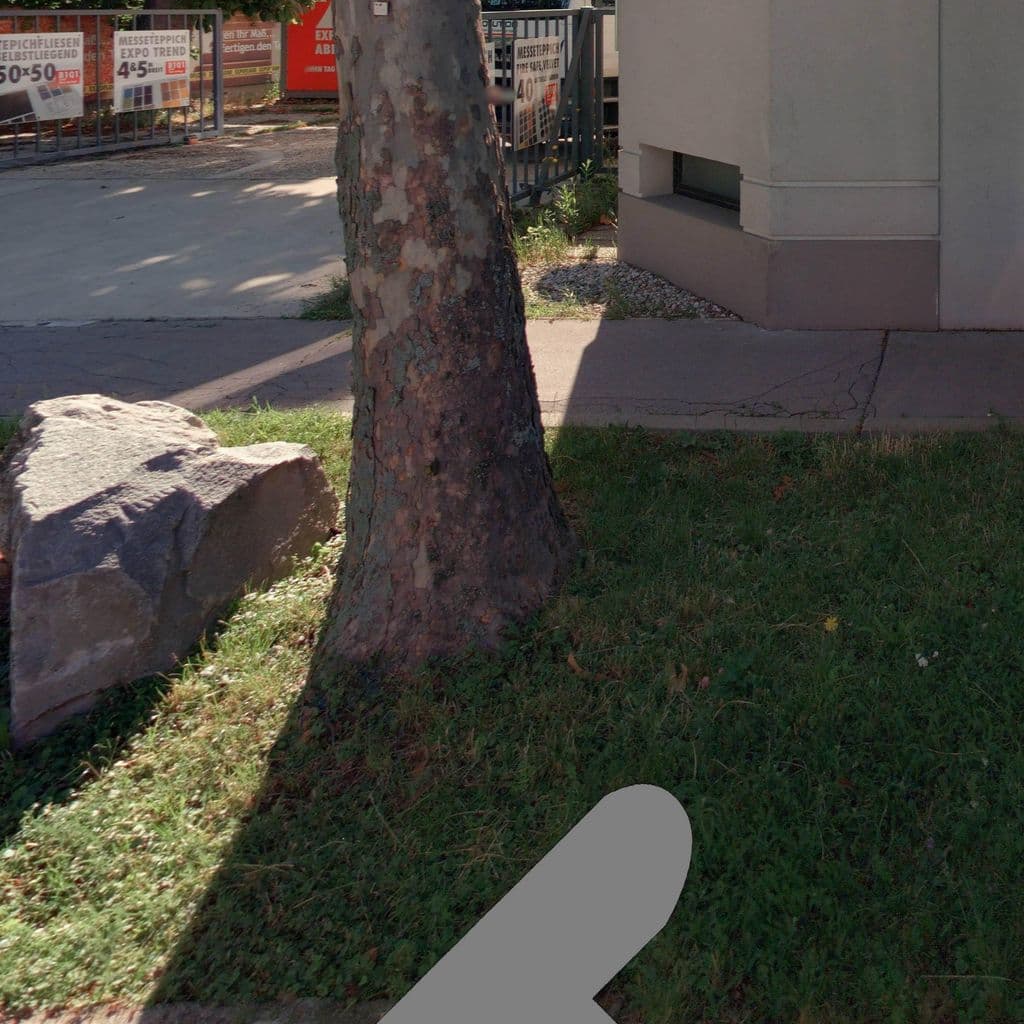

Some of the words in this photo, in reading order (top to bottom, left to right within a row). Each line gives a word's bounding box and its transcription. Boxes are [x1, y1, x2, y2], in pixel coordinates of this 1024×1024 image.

[119, 34, 187, 46] MESSETEPPICH
[0, 49, 78, 62] ELBSTLIEGEND
[120, 47, 149, 59] EXPO
[153, 46, 187, 57] TREND
